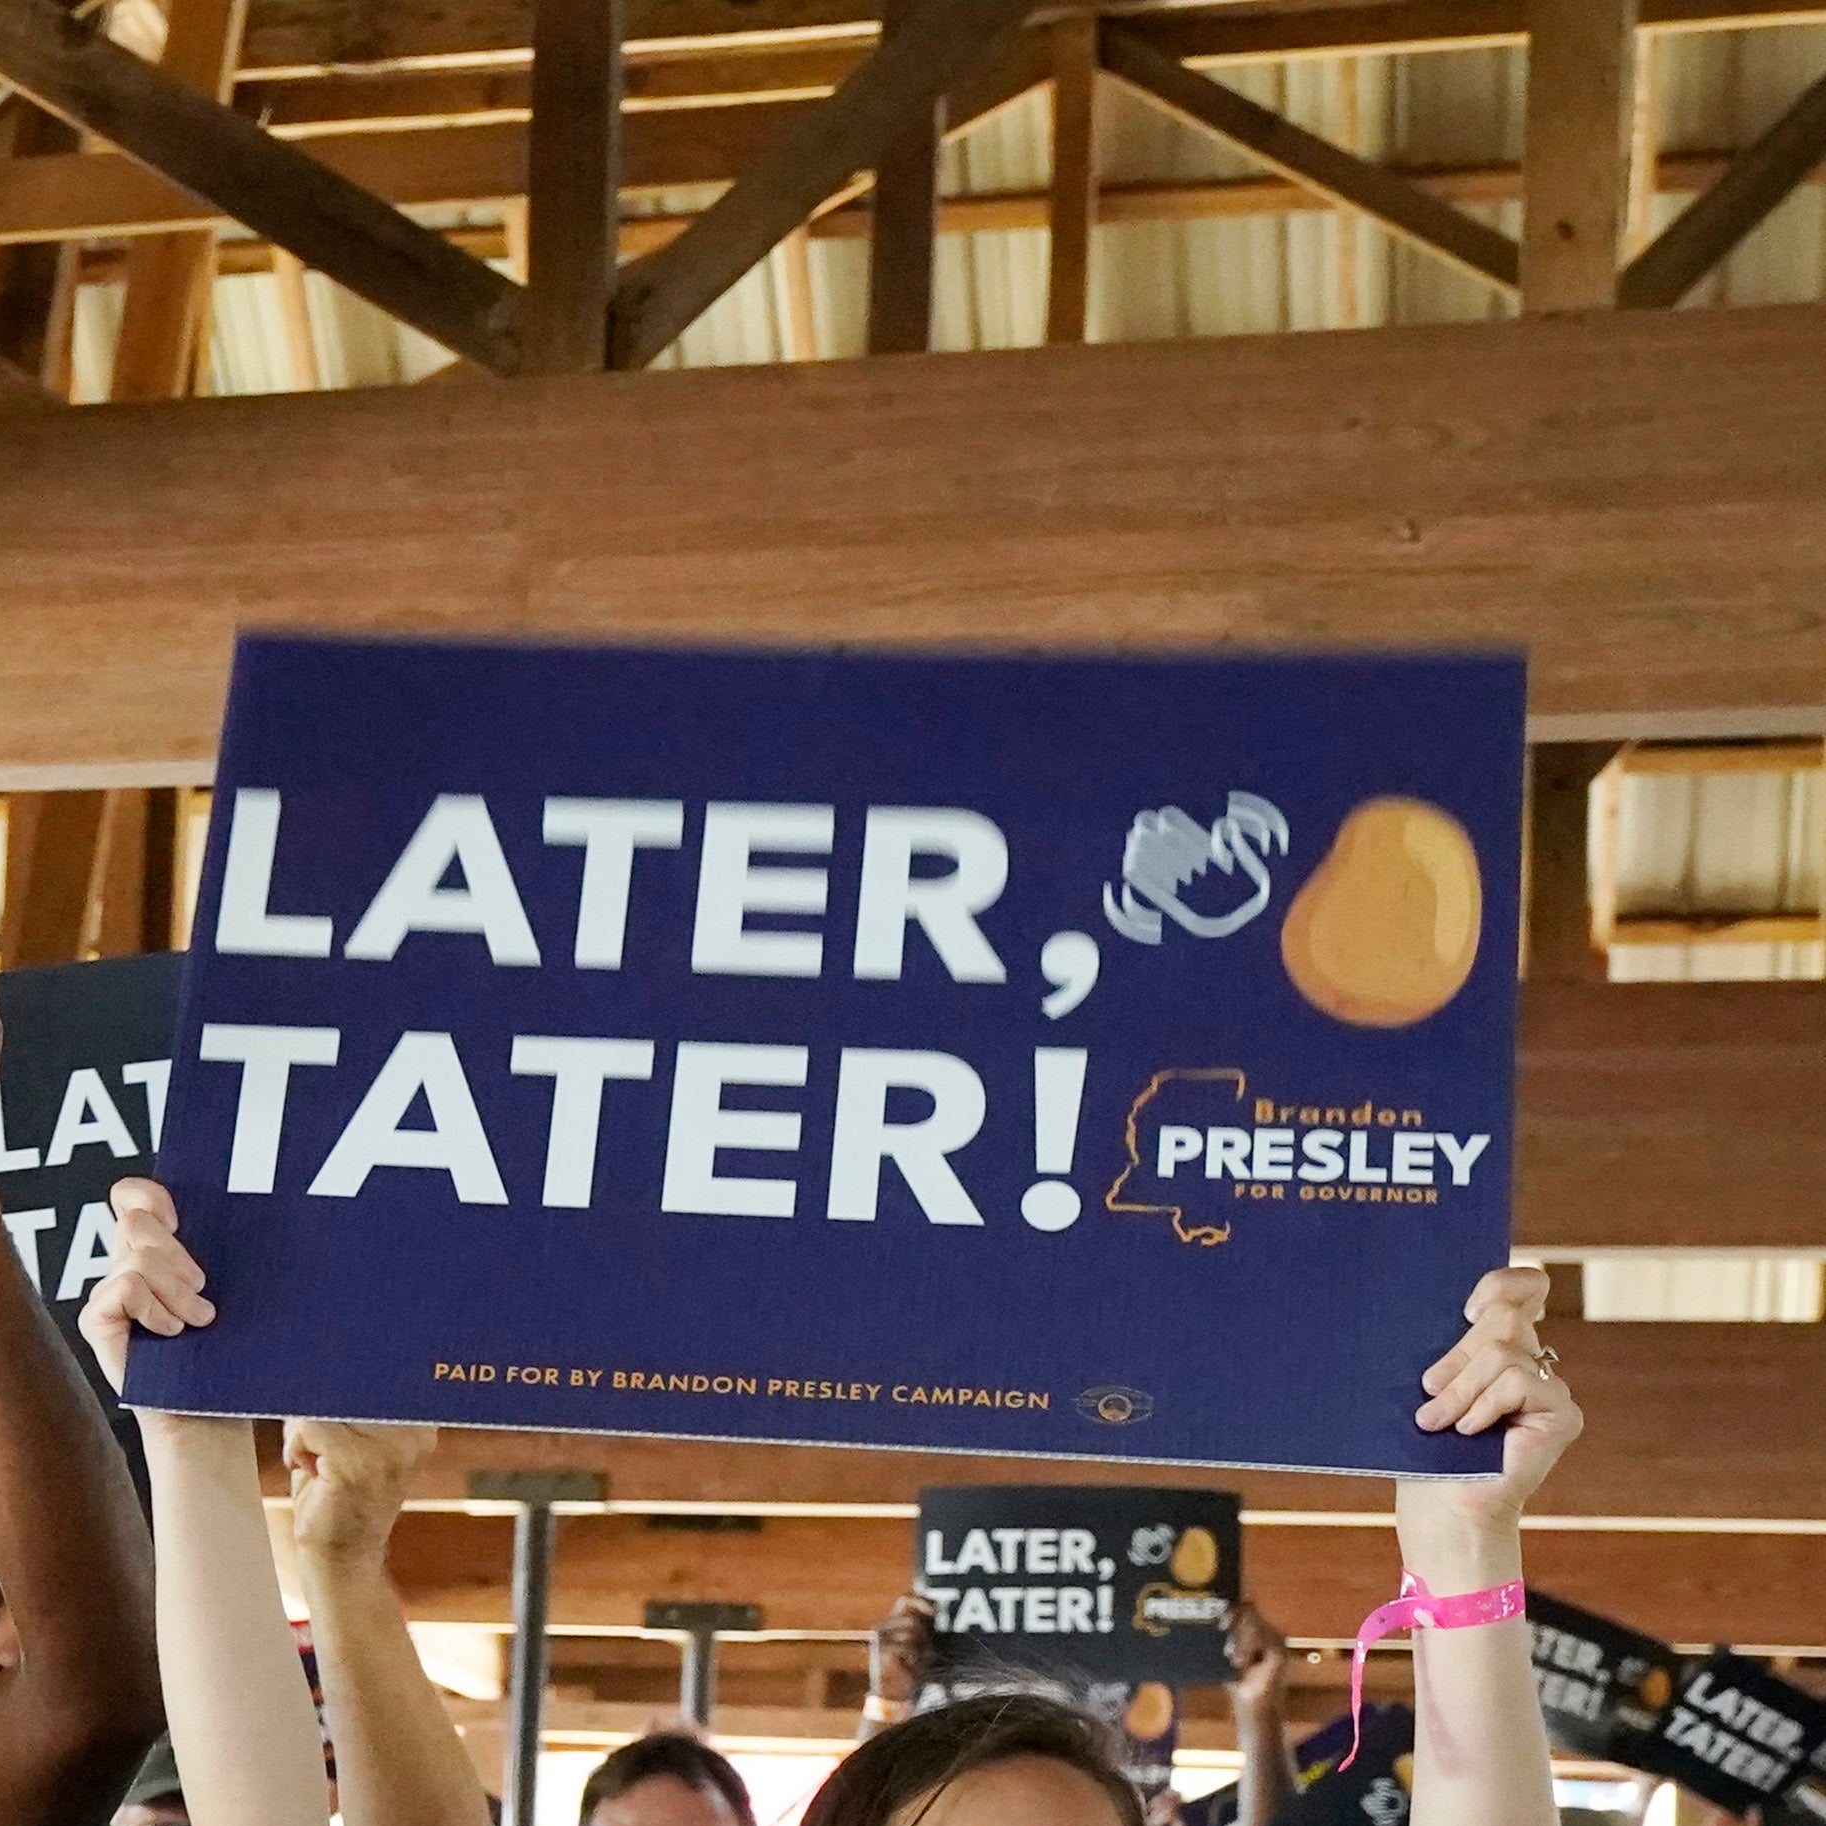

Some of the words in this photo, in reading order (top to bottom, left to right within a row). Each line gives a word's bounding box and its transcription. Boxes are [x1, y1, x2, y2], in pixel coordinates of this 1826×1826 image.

[215, 786, 1101, 1020] LATER,
[199, 1022, 1088, 1232] TATER!
[1254, 1098, 1423, 1128] Brandon
[1156, 1125, 1492, 1187] PRESLEY
[1234, 1183, 1285, 1201] FOR
[1298, 1184, 1439, 1206] GOVERNOR
[434, 1362, 496, 1384] PAID
[505, 1366, 560, 1387] FOR
[569, 1369, 604, 1389] BY
[612, 1371, 758, 1397] BRANDON
[767, 1379, 882, 1404] PRESLEY
[892, 1384, 1051, 1411] CAMPAIGN
[924, 1527, 1116, 1582] LATER,
[925, 1585, 1115, 1634] TATER!
